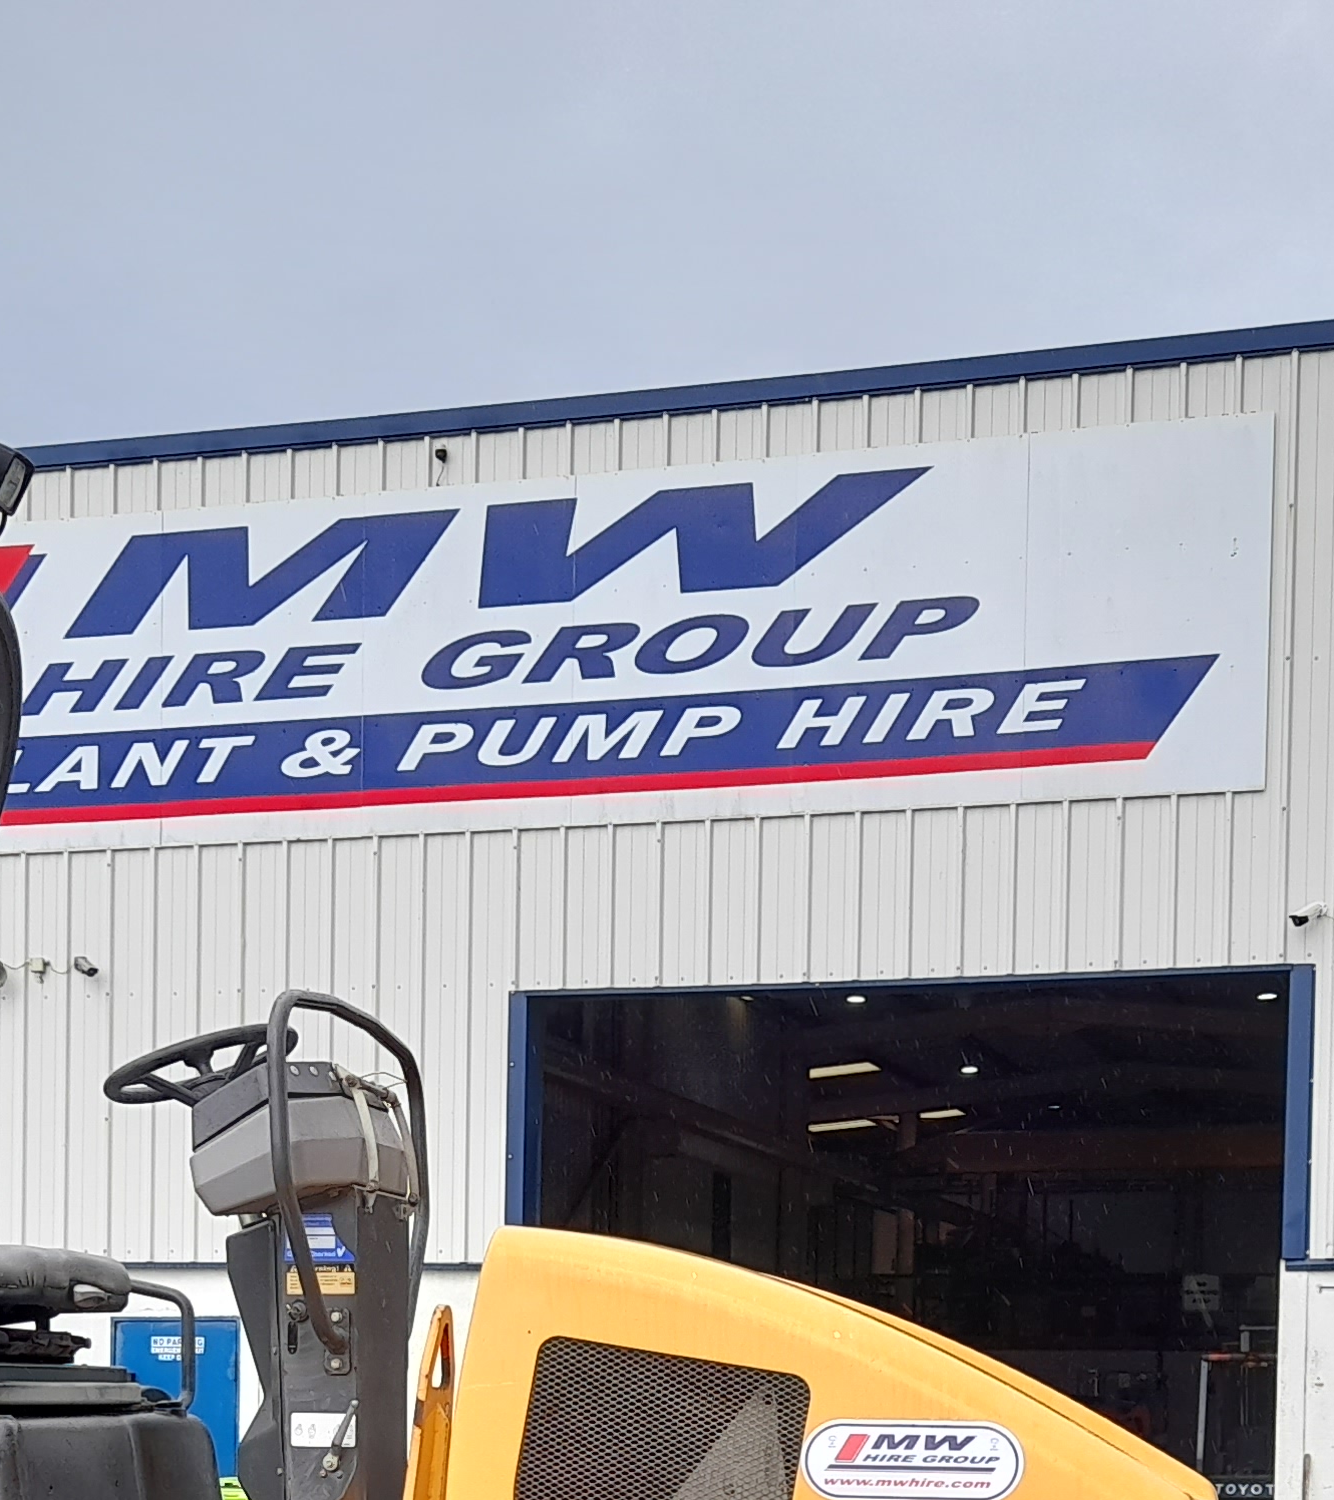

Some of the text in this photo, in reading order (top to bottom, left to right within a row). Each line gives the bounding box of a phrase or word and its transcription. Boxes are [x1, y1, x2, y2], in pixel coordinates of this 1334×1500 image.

[64, 466, 933, 639] MW
[22, 596, 980, 716] HIRE GROUP
[280, 729, 361, 779] &
[397, 705, 743, 772] PUMP
[776, 678, 1087, 751] HIRE
[871, 1433, 977, 1451] MW
[862, 1454, 1001, 1465] HIRE GROUP
[823, 1476, 992, 1489] www.mwhire.com
[1215, 1483, 1274, 1496] TOYOT
